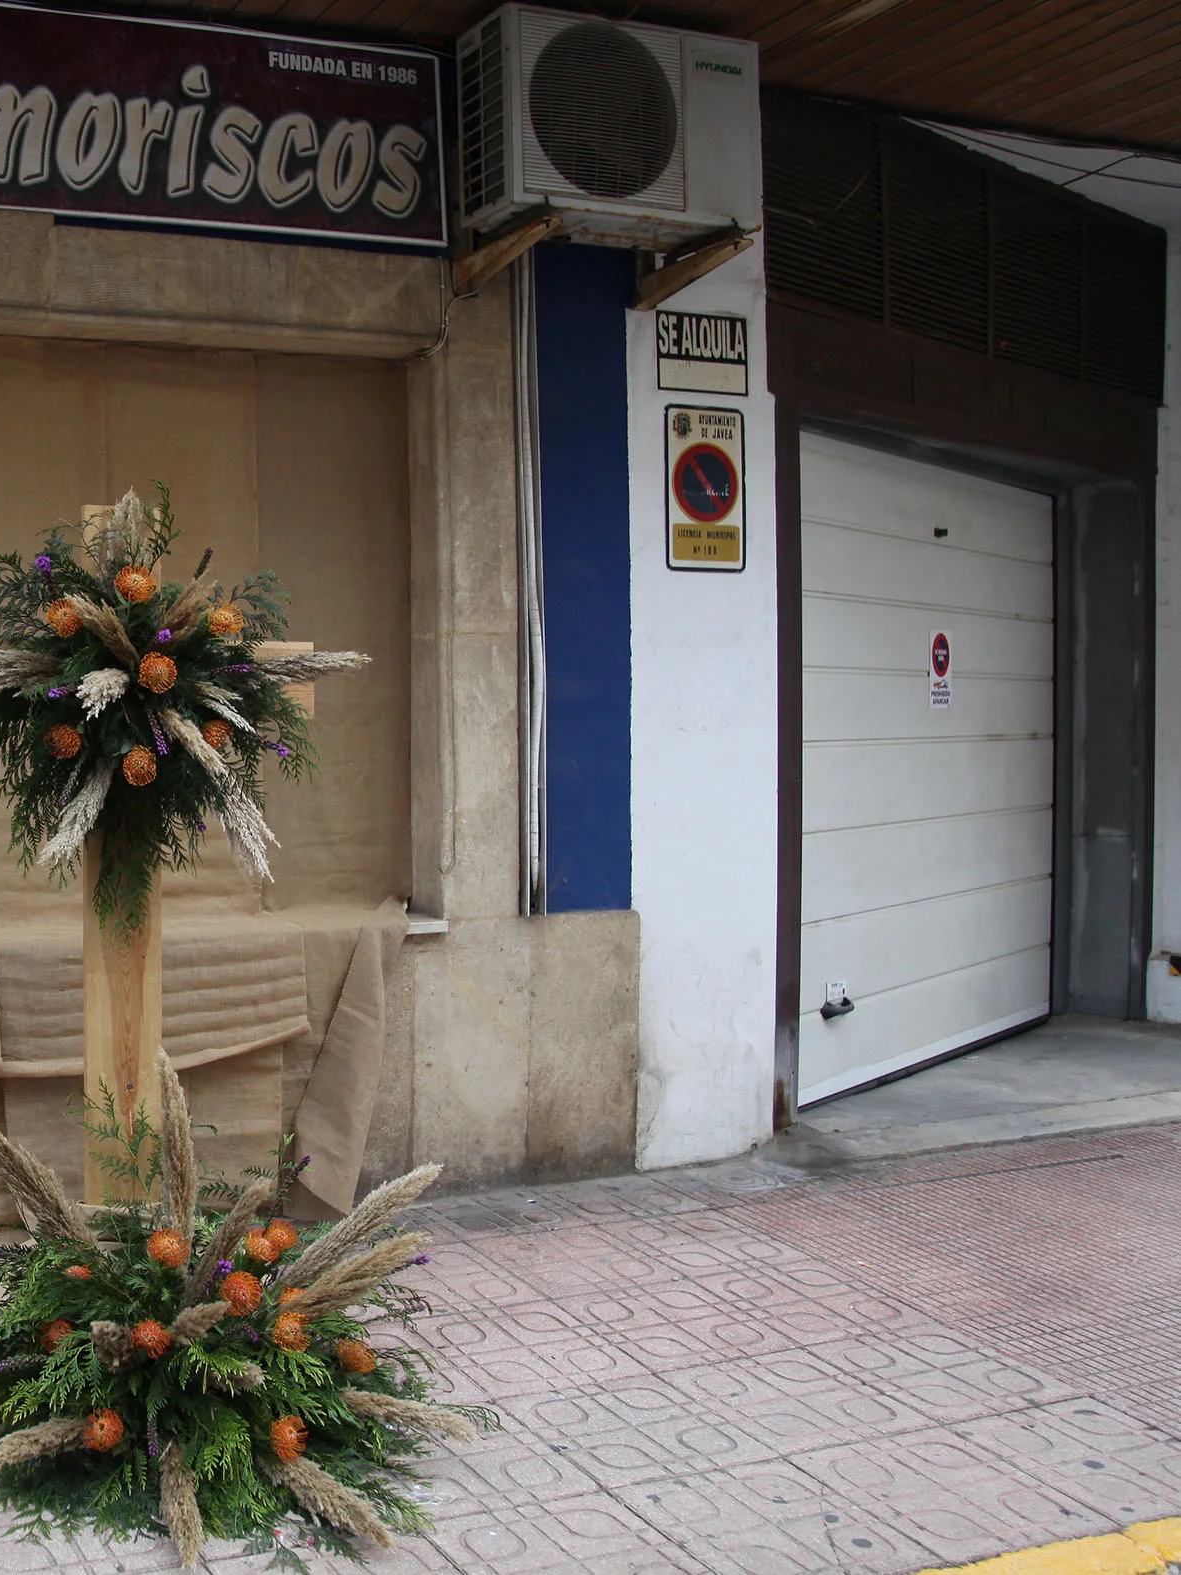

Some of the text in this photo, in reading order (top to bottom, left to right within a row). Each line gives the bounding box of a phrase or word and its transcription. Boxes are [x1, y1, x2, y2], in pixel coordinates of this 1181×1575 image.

[269, 50, 418, 85] FUNDADA EN 1986
[695, 60, 742, 76] HYUNDAI
[658, 313, 745, 360] SE ALQUILA
[698, 414, 736, 428] AYUNTAMIENTO
[701, 428, 733, 440] DE JAVEA
[677, 529, 736, 540] LICENCIA MUNICIPAL
